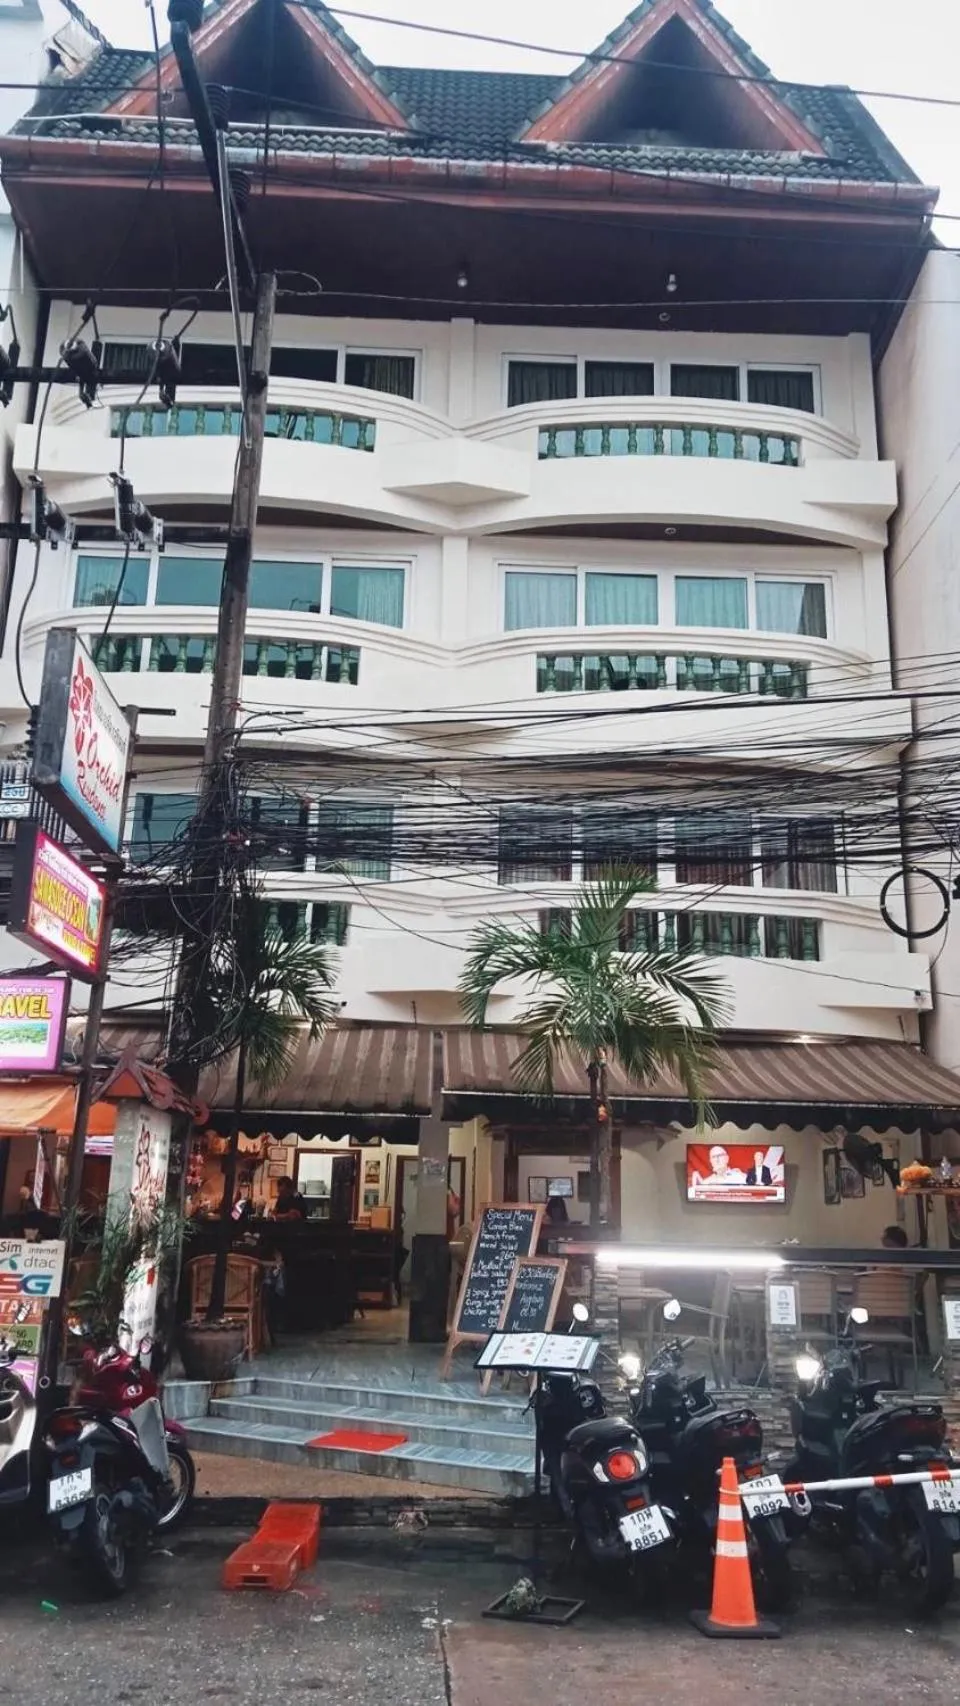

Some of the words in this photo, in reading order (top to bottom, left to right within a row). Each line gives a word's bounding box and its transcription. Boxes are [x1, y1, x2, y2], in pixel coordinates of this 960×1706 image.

[87, 731, 122, 801] Orchid
[0, 993, 52, 1019] AVEL
[487, 1209, 512, 1221] Special
[513, 1210, 533, 1222] Menu
[23, 1257, 56, 1269] dtac
[0, 1299, 38, 1313] TAI
[634, 1529, 665, 1549] 8851
